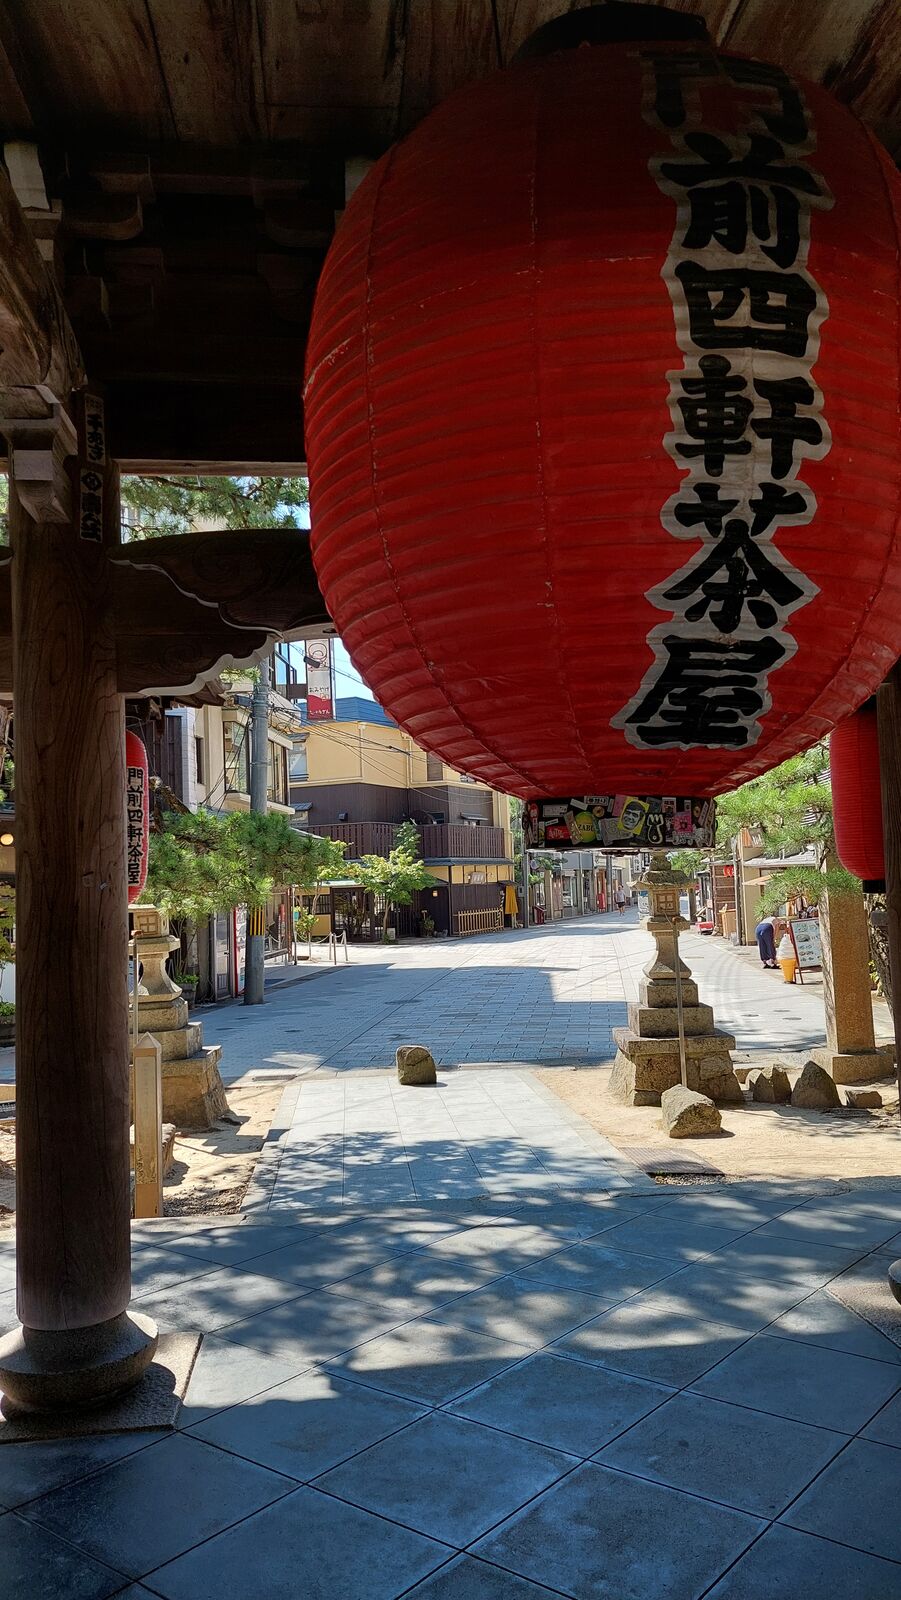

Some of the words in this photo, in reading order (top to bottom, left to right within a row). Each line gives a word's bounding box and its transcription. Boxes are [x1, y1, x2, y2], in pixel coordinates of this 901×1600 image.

[625, 51, 825, 746] 門前四軒茶屋
[127, 767, 143, 885] 門前四軒茶屋
